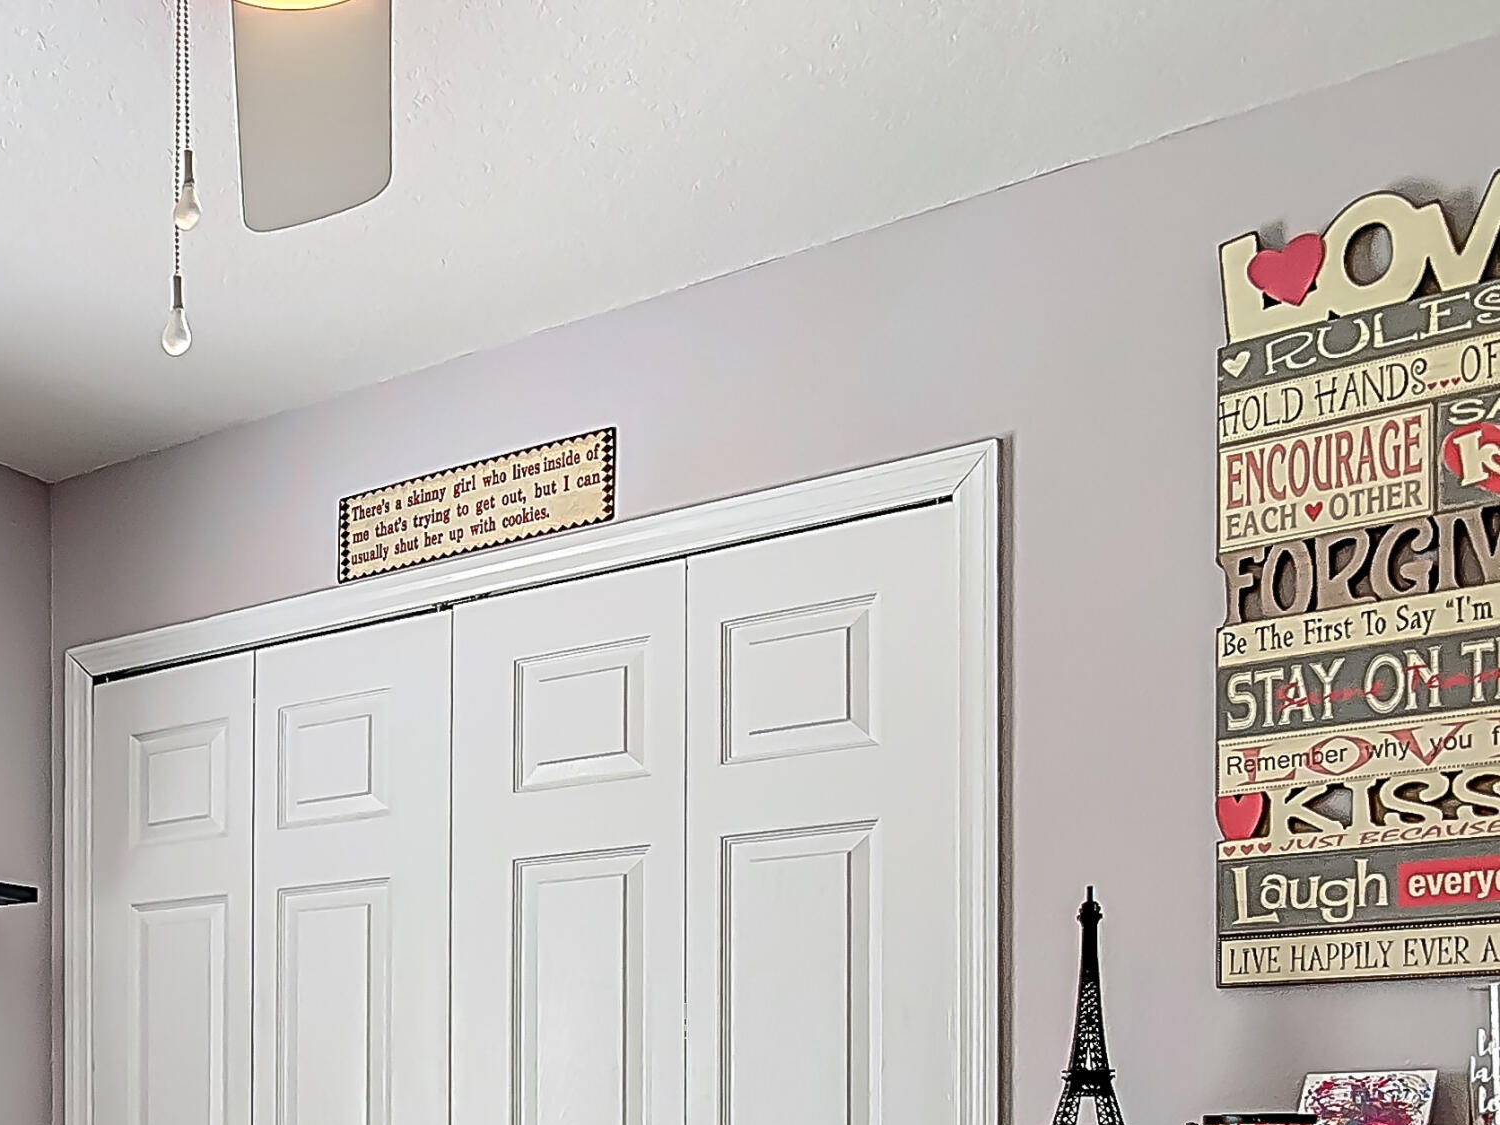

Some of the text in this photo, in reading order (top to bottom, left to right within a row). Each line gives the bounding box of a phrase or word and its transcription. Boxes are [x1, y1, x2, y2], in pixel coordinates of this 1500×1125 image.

[1264, 286, 1500, 377] RULES
[1219, 387, 1303, 437] HOLD
[1315, 357, 1427, 416] HANDS
[351, 443, 600, 521] There's a skinny girl who lives inside of
[1226, 415, 1422, 510] ENCOURAGE
[351, 508, 550, 565] usually shut her up with cookies.
[352, 472, 600, 544] me that's trying to get out, but I can
[1226, 479, 1422, 541] EACH OTHER
[1223, 632, 1246, 657] Be
[1255, 624, 1293, 652] The
[1303, 618, 1353, 645] First
[1361, 609, 1386, 636] To
[1396, 604, 1436, 636] Say
[1227, 657, 1346, 730] STAY
[1364, 644, 1442, 714] ON
[1227, 747, 1347, 776] Remember
[1366, 739, 1409, 762] why
[1431, 732, 1472, 755] you
[1279, 819, 1500, 851] JUST BECAUSE
[1231, 859, 1389, 925] Laugh
[1403, 935, 1470, 967] EVER
